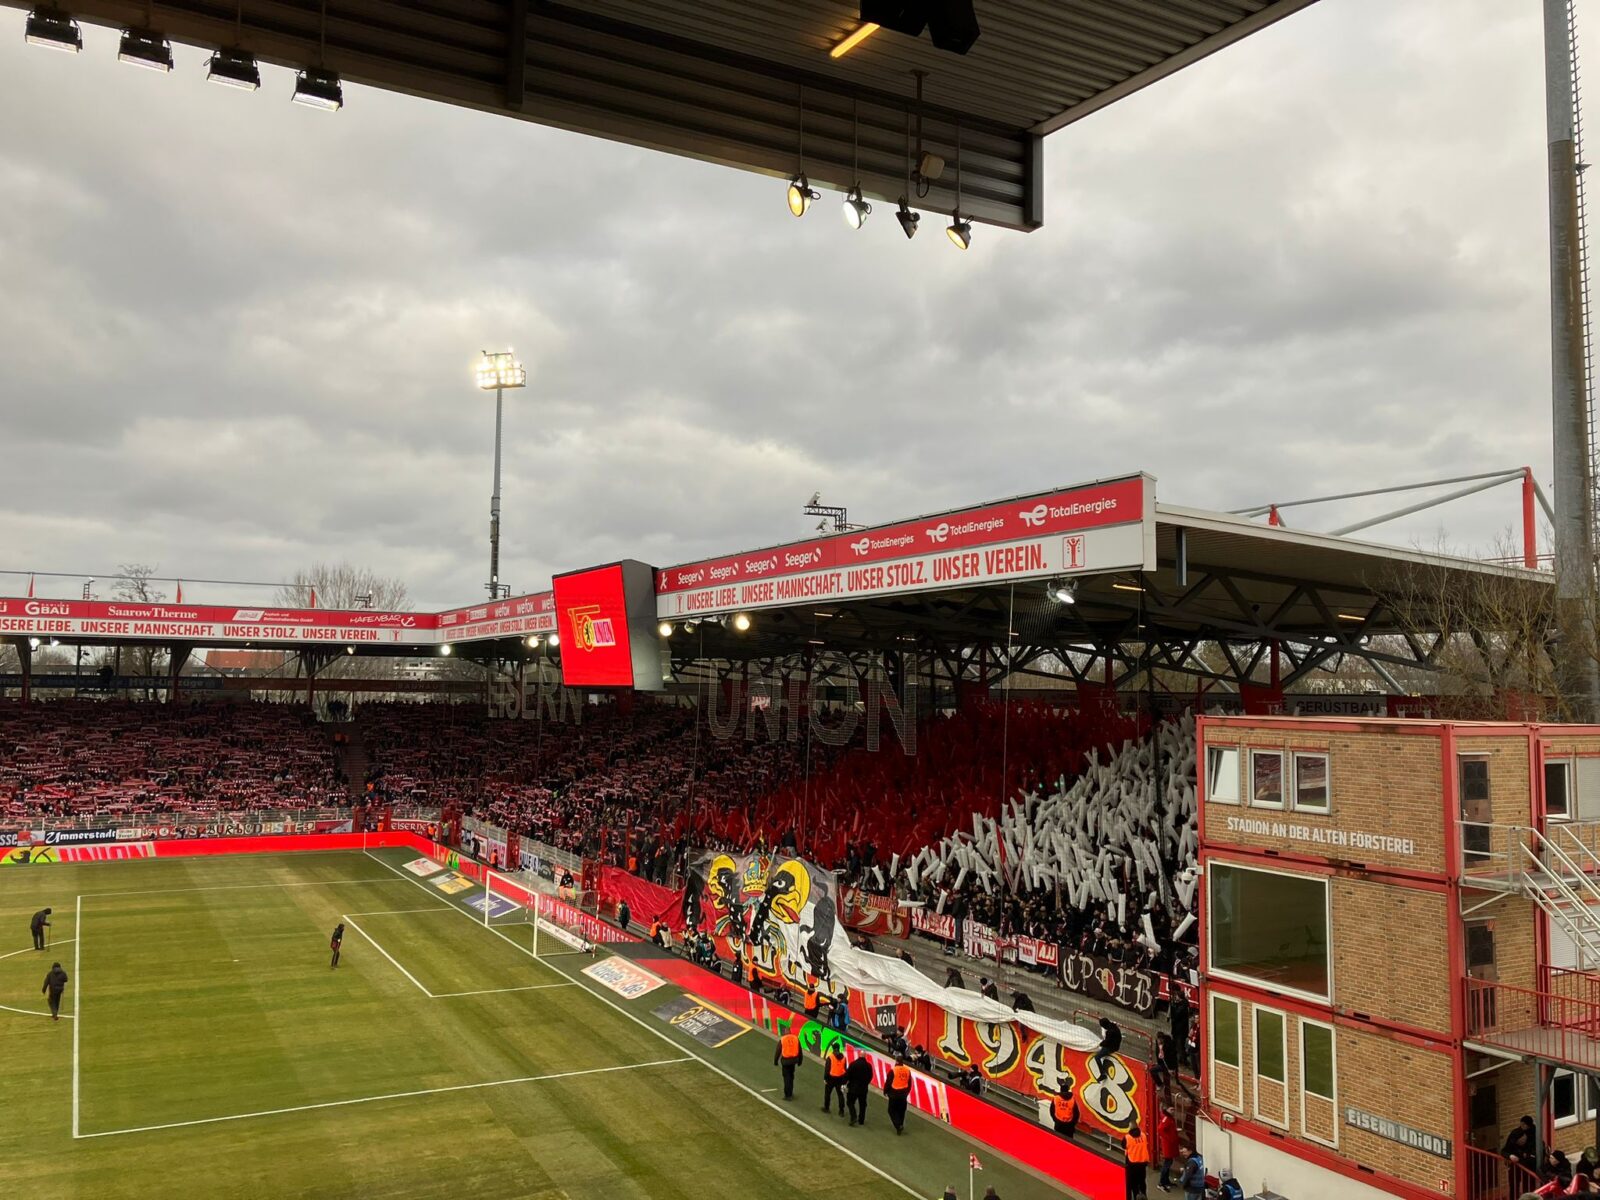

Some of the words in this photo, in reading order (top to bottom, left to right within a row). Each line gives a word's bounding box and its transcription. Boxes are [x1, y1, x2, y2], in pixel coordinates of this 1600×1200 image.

[1049, 498, 1117, 519] TotalEnergies
[950, 518, 1004, 536] TotalEnergies
[871, 534, 914, 551] TotalEnergies
[745, 560, 770, 575] Seeger
[785, 553, 813, 568] Seeger
[678, 573, 699, 586] Seeger
[687, 590, 713, 610] UNSERE
[716, 587, 738, 607] LIEBE.
[742, 580, 774, 604] UNSERE
[776, 573, 843, 600] MANNSCHAFT.
[848, 569, 884, 593] UNSER
[887, 561, 927, 586] STOLZ.
[933, 550, 979, 582] UNSER
[985, 543, 1046, 576] VEREIN.
[710, 567, 731, 580] Seeger
[37, 620, 75, 632] LIEBE.
[81, 621, 128, 634] UNSERE
[134, 623, 215, 636] MANNSCHAFT.
[224, 625, 260, 637] UNSER
[264, 627, 298, 639] STOLZ.
[302, 628, 336, 640] UNSER
[340, 629, 380, 641] VEREIN.
[708, 650, 917, 755] UNION
[1296, 700, 1381, 715] GERÜSTBAU
[1228, 816, 1270, 836] STADION
[1272, 823, 1287, 838] AN
[1289, 826, 1310, 841] DER
[1313, 829, 1348, 846] ALTEN
[1350, 830, 1414, 855] FÖRSTEREI
[877, 1010, 896, 1027] KÖLN
[939, 1010, 1139, 1130] 1948
